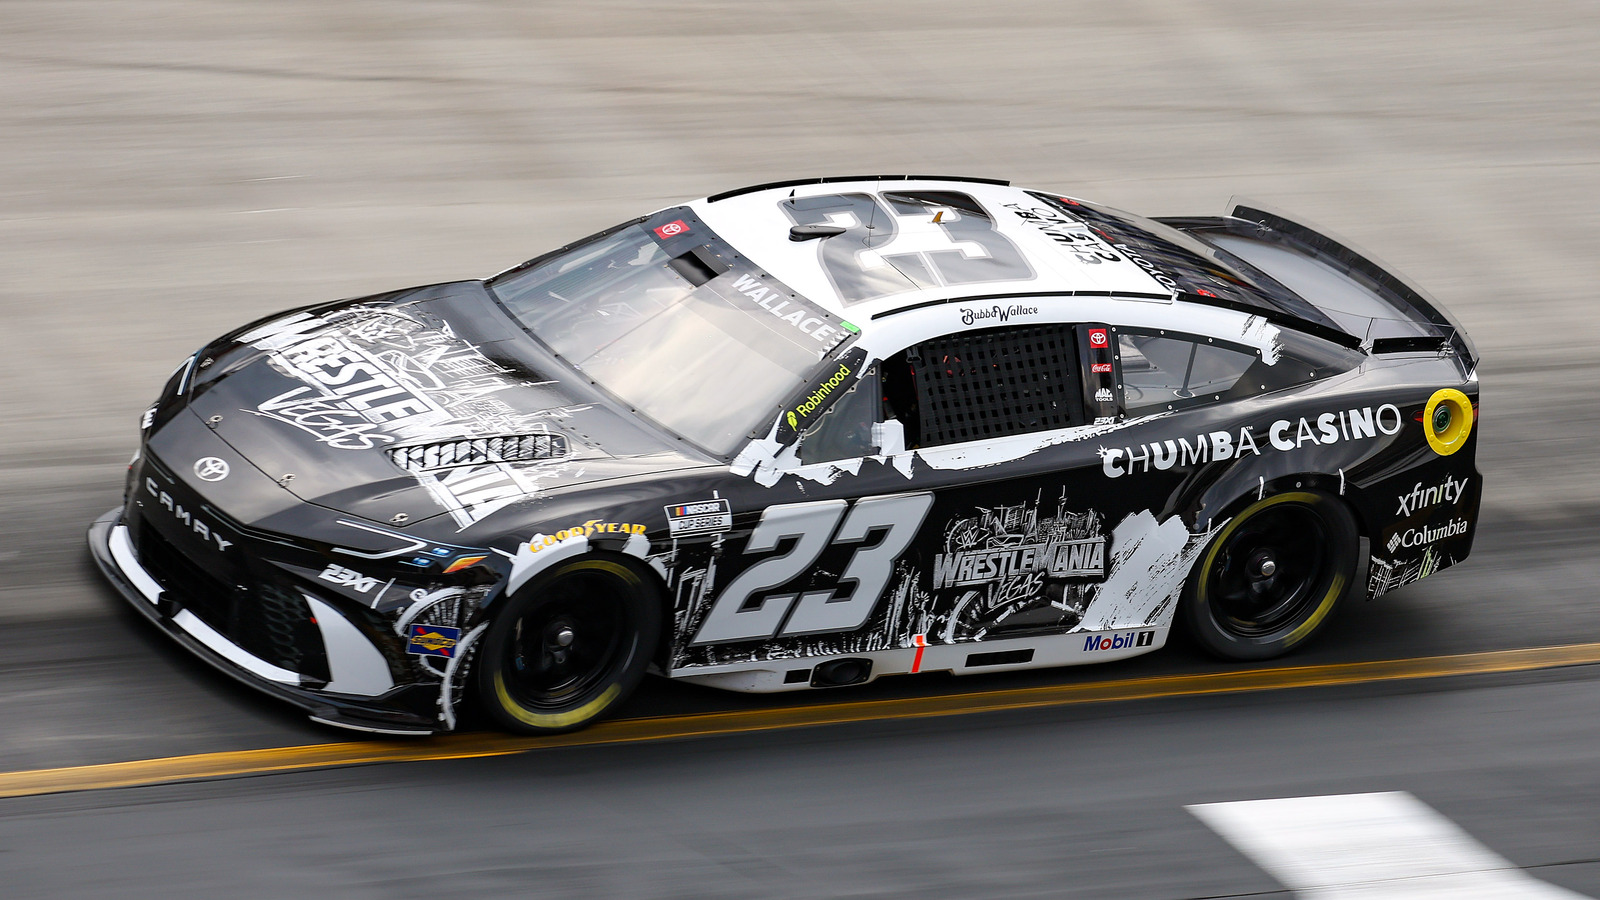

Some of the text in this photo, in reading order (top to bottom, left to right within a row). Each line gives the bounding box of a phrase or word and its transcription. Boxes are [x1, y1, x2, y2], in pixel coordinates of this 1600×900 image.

[776, 191, 1038, 309] 23
[1031, 207, 1121, 262] CASNO
[731, 273, 836, 342] WALLACE
[960, 305, 1038, 325] Bubba Wallace
[796, 364, 851, 418] Robinhood
[1269, 403, 1402, 451] CASINO
[146, 476, 234, 551] CAMRY
[686, 502, 721, 514] NASCAR
[1395, 475, 1469, 517] xfinity
[529, 519, 647, 553] GOODYEAR
[679, 516, 724, 530] CUP SERIES
[1401, 517, 1468, 548] Columbia
[689, 491, 935, 647] 23
[933, 538, 1105, 591] WRESTLEMANIA
[987, 571, 1046, 610] VEGAS
[1083, 632, 1135, 652] Mobil
